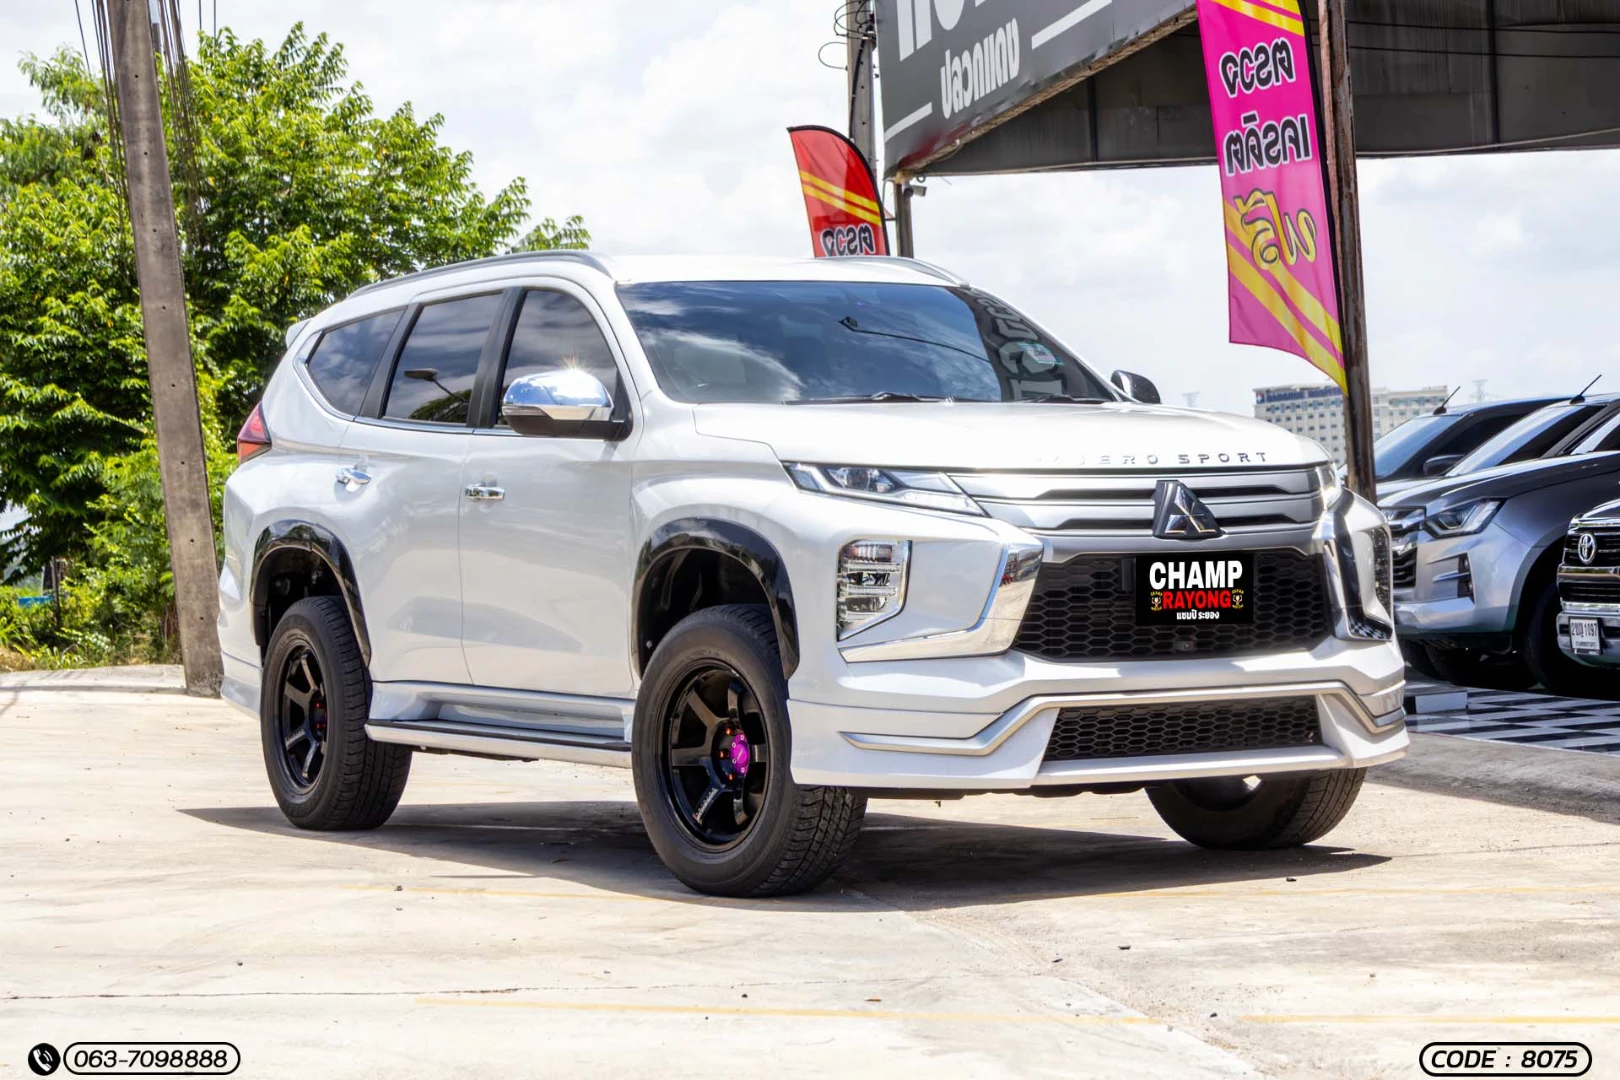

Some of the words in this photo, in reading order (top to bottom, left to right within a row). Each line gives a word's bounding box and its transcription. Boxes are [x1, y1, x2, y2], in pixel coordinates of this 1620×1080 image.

[940, 17, 1020, 120] ปลวกแดง
[1178, 452, 1267, 464] SPORT
[1149, 560, 1243, 590] CHAMP
[1161, 590, 1232, 610] RAYONG
[1198, 611, 1220, 620] ระยอง
